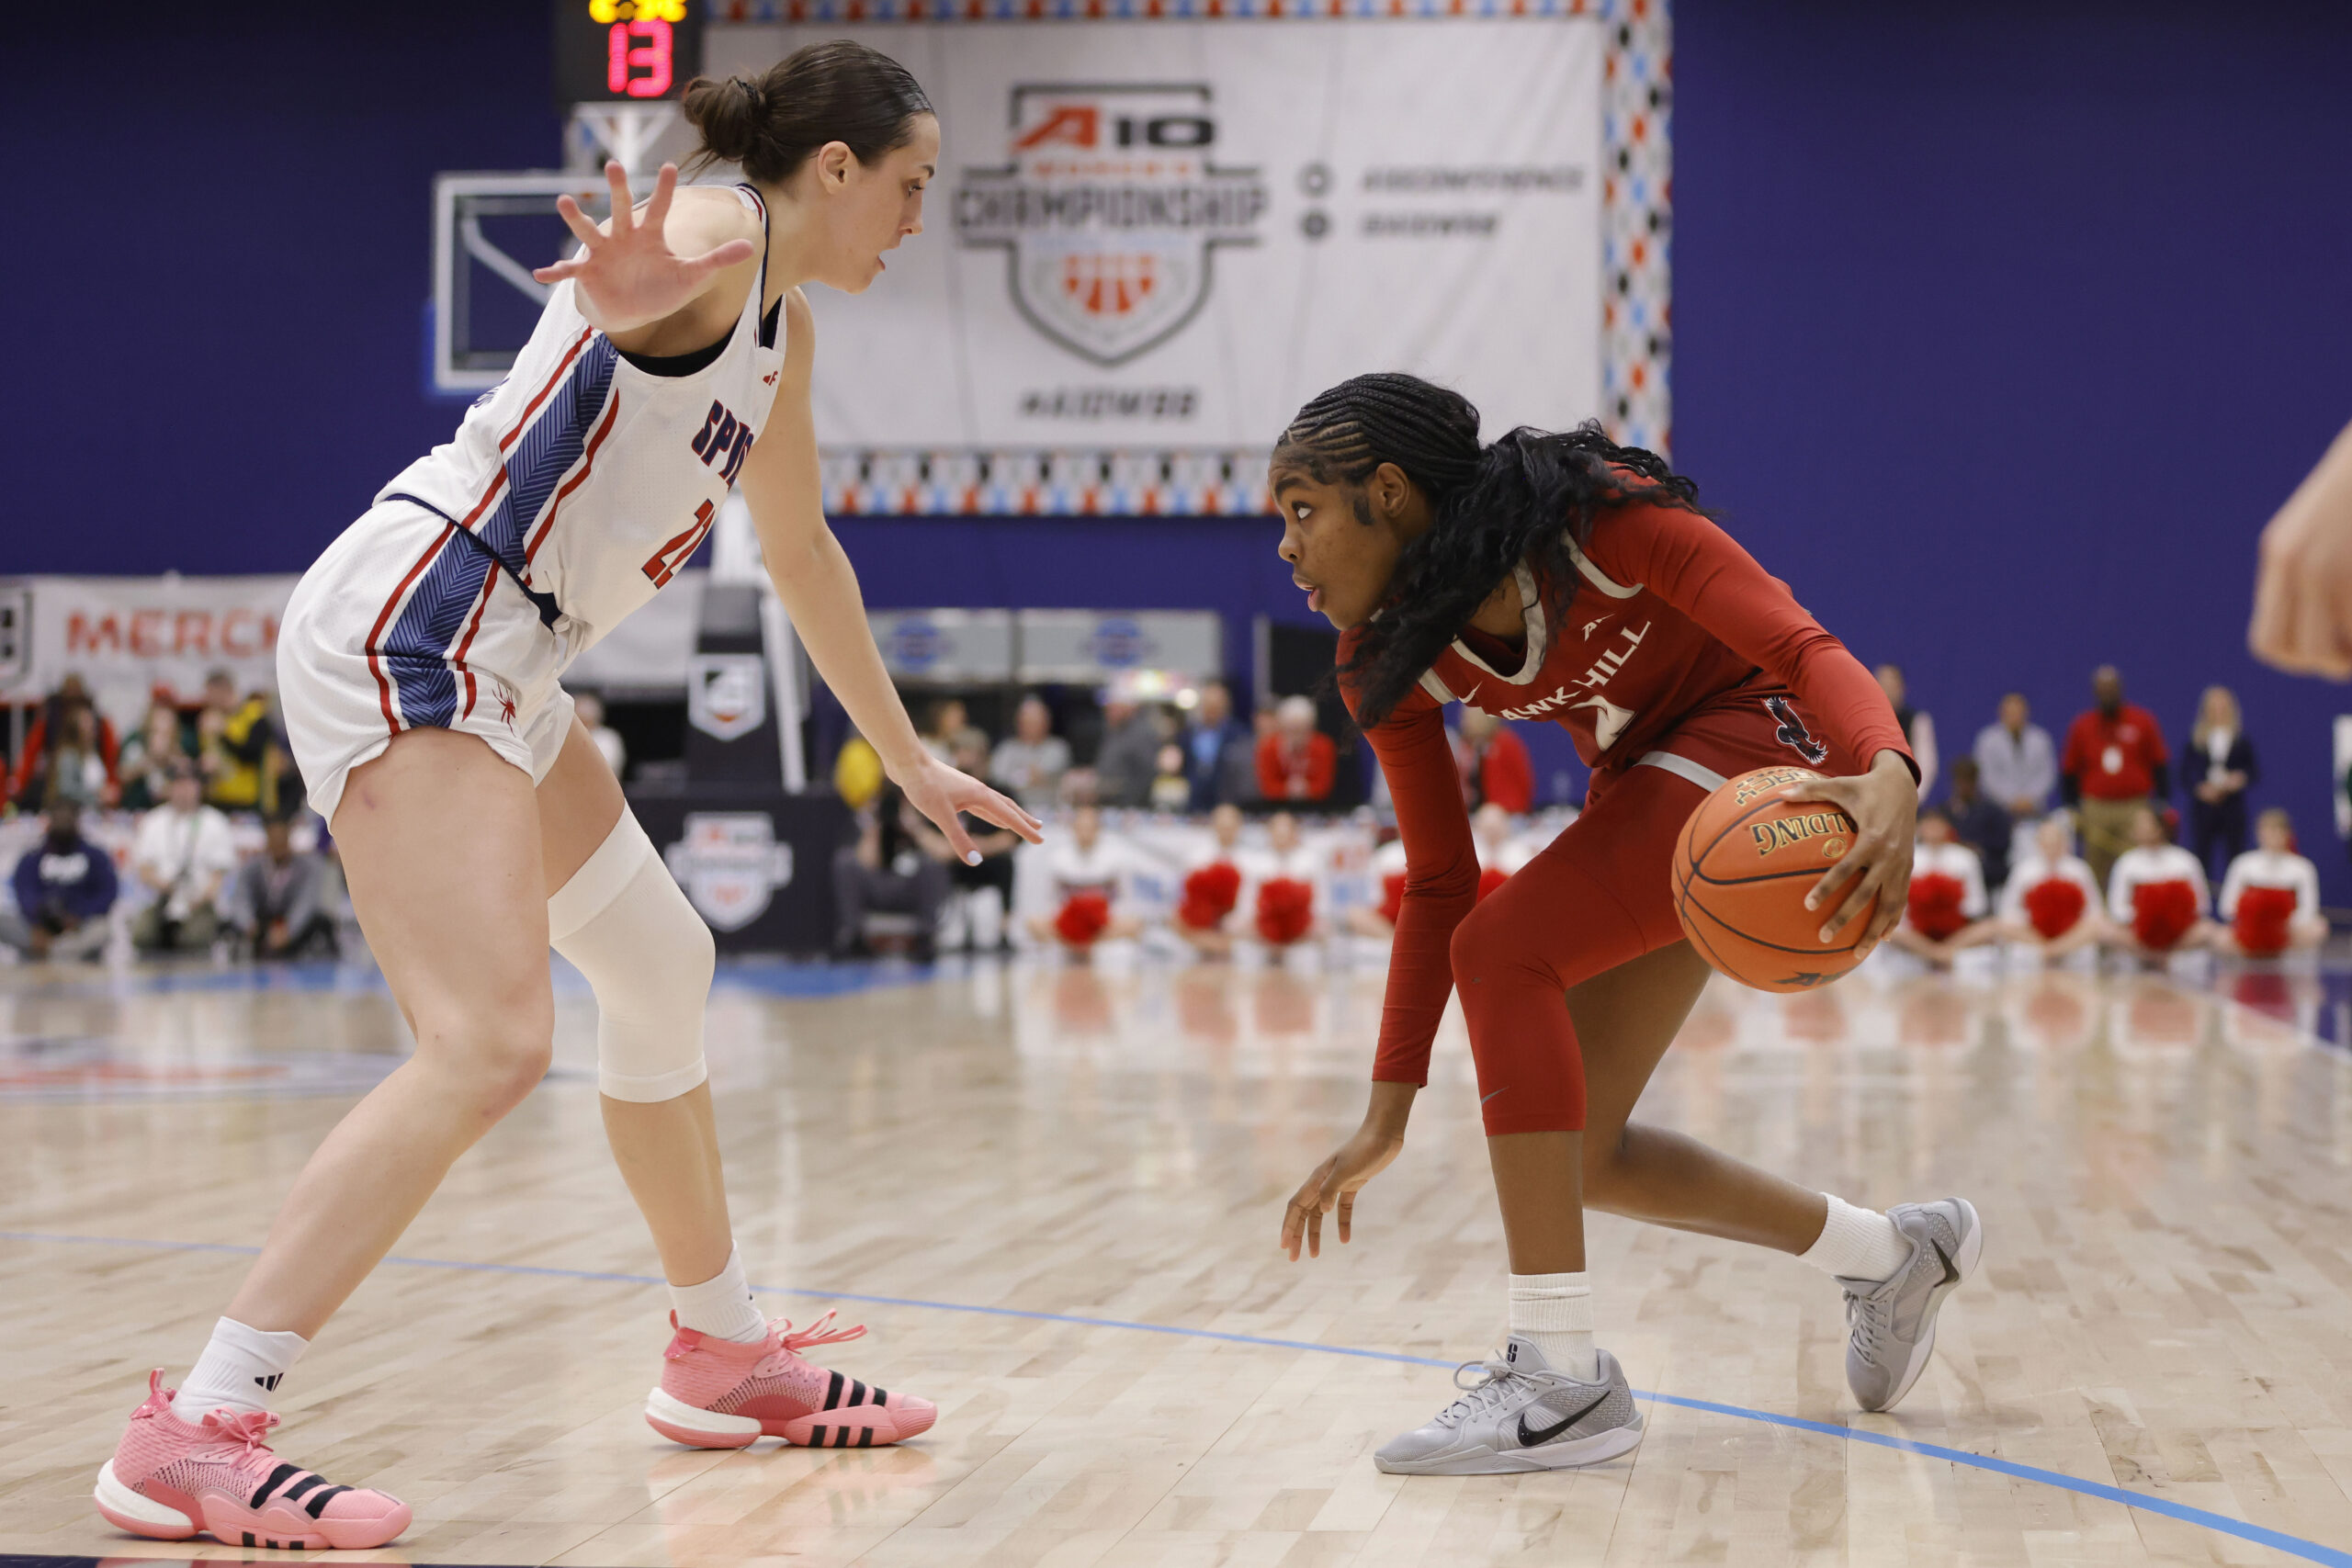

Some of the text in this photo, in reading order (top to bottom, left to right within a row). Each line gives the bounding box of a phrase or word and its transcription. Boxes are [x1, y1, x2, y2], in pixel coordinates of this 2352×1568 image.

[607, 18, 673, 97] 13
[950, 185, 1272, 229] CHAMPIONSHIP
[1487, 686, 1581, 720] AWK
[1570, 620, 1652, 687] HILL
